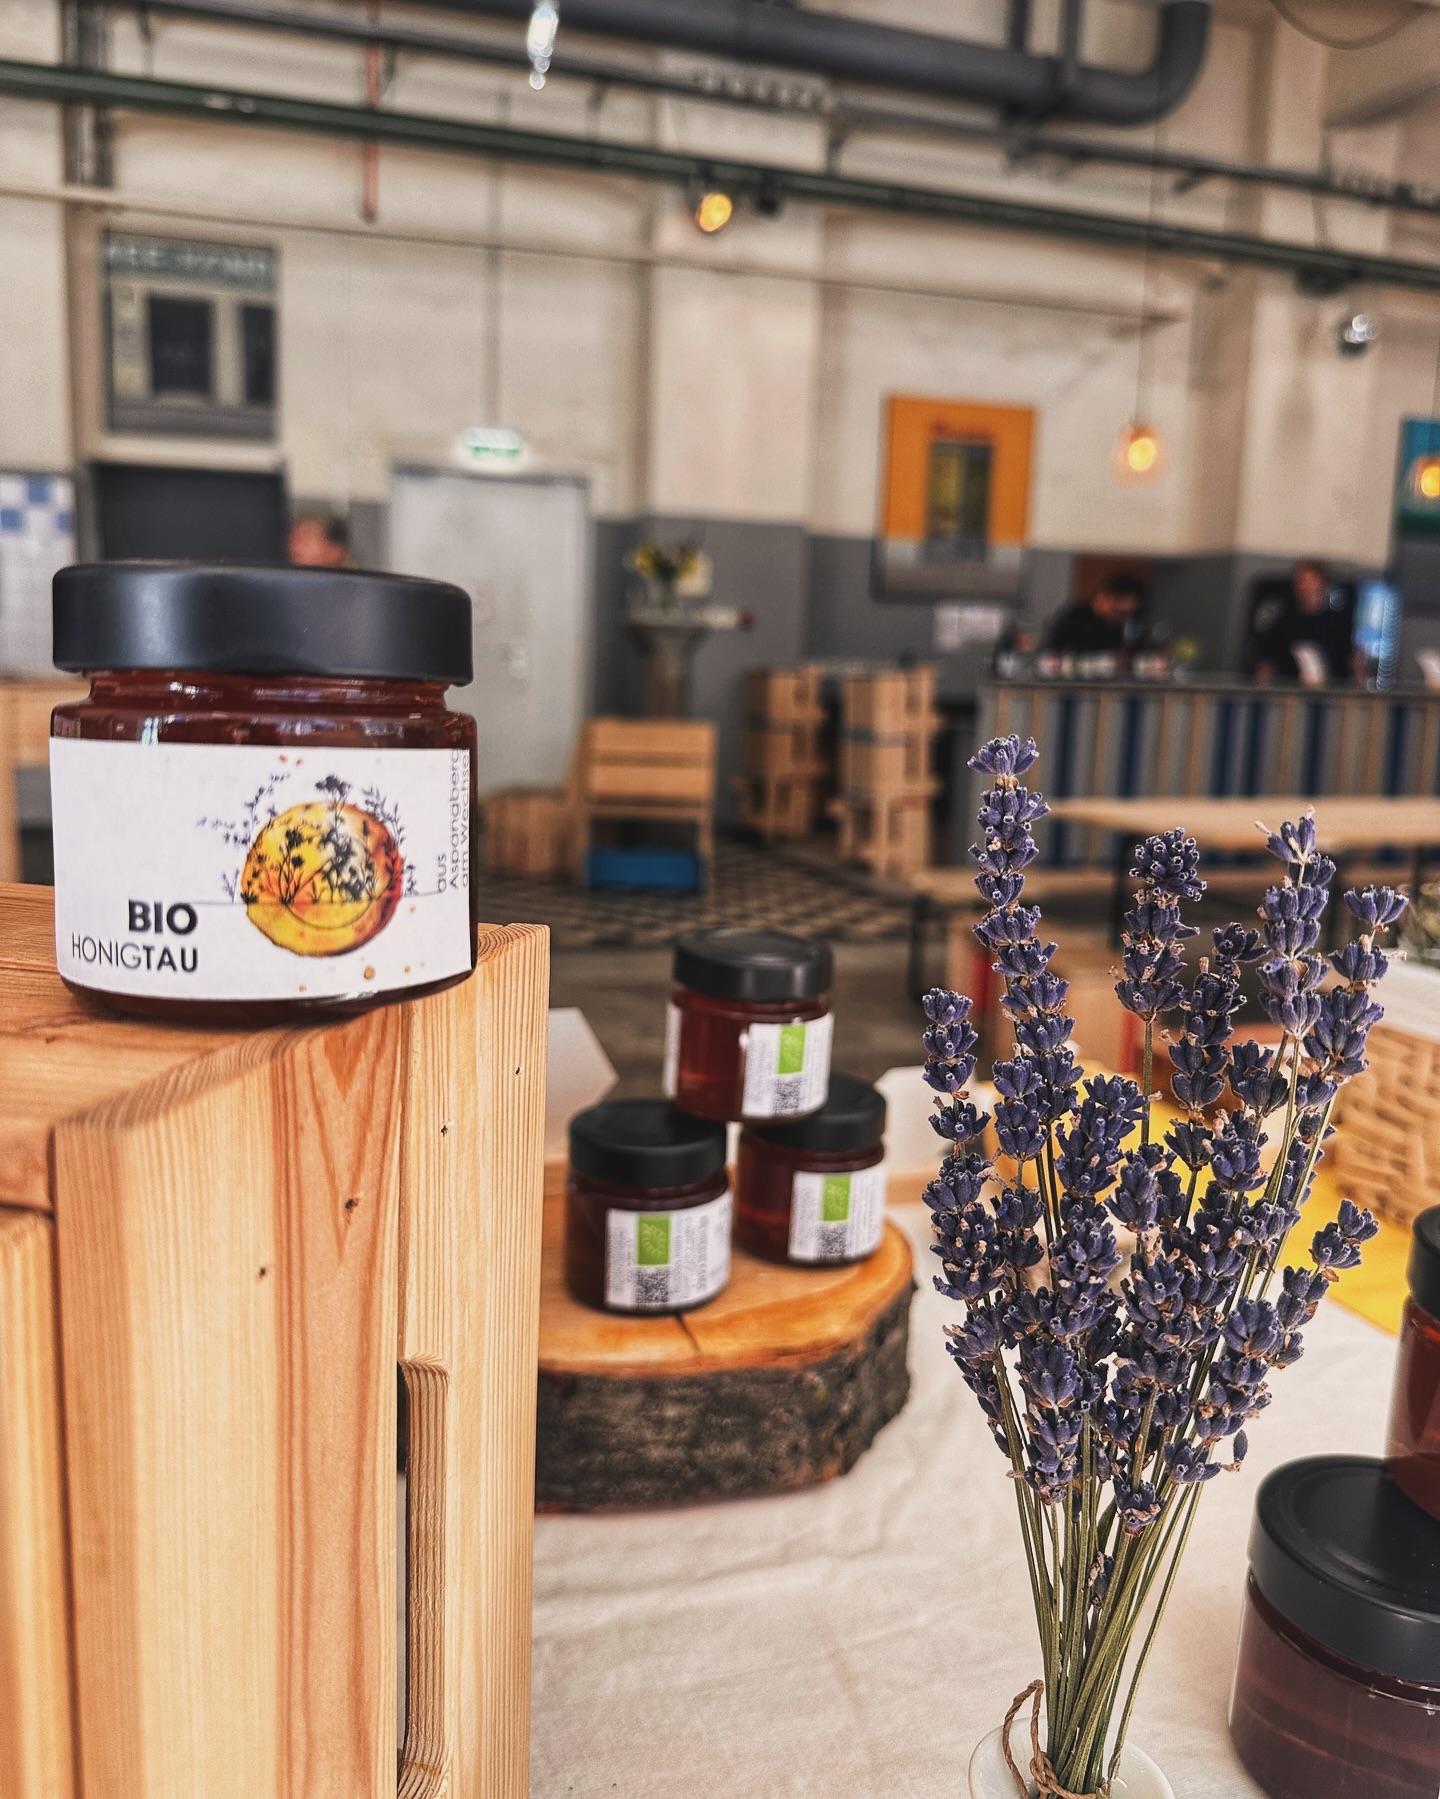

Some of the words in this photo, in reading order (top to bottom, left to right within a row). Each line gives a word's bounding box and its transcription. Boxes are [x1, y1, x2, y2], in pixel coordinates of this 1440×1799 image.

[438, 853, 447, 892] aus
[461, 852, 469, 887] am
[128, 899, 198, 935] BIO
[72, 932, 198, 973] HONIGTAU
